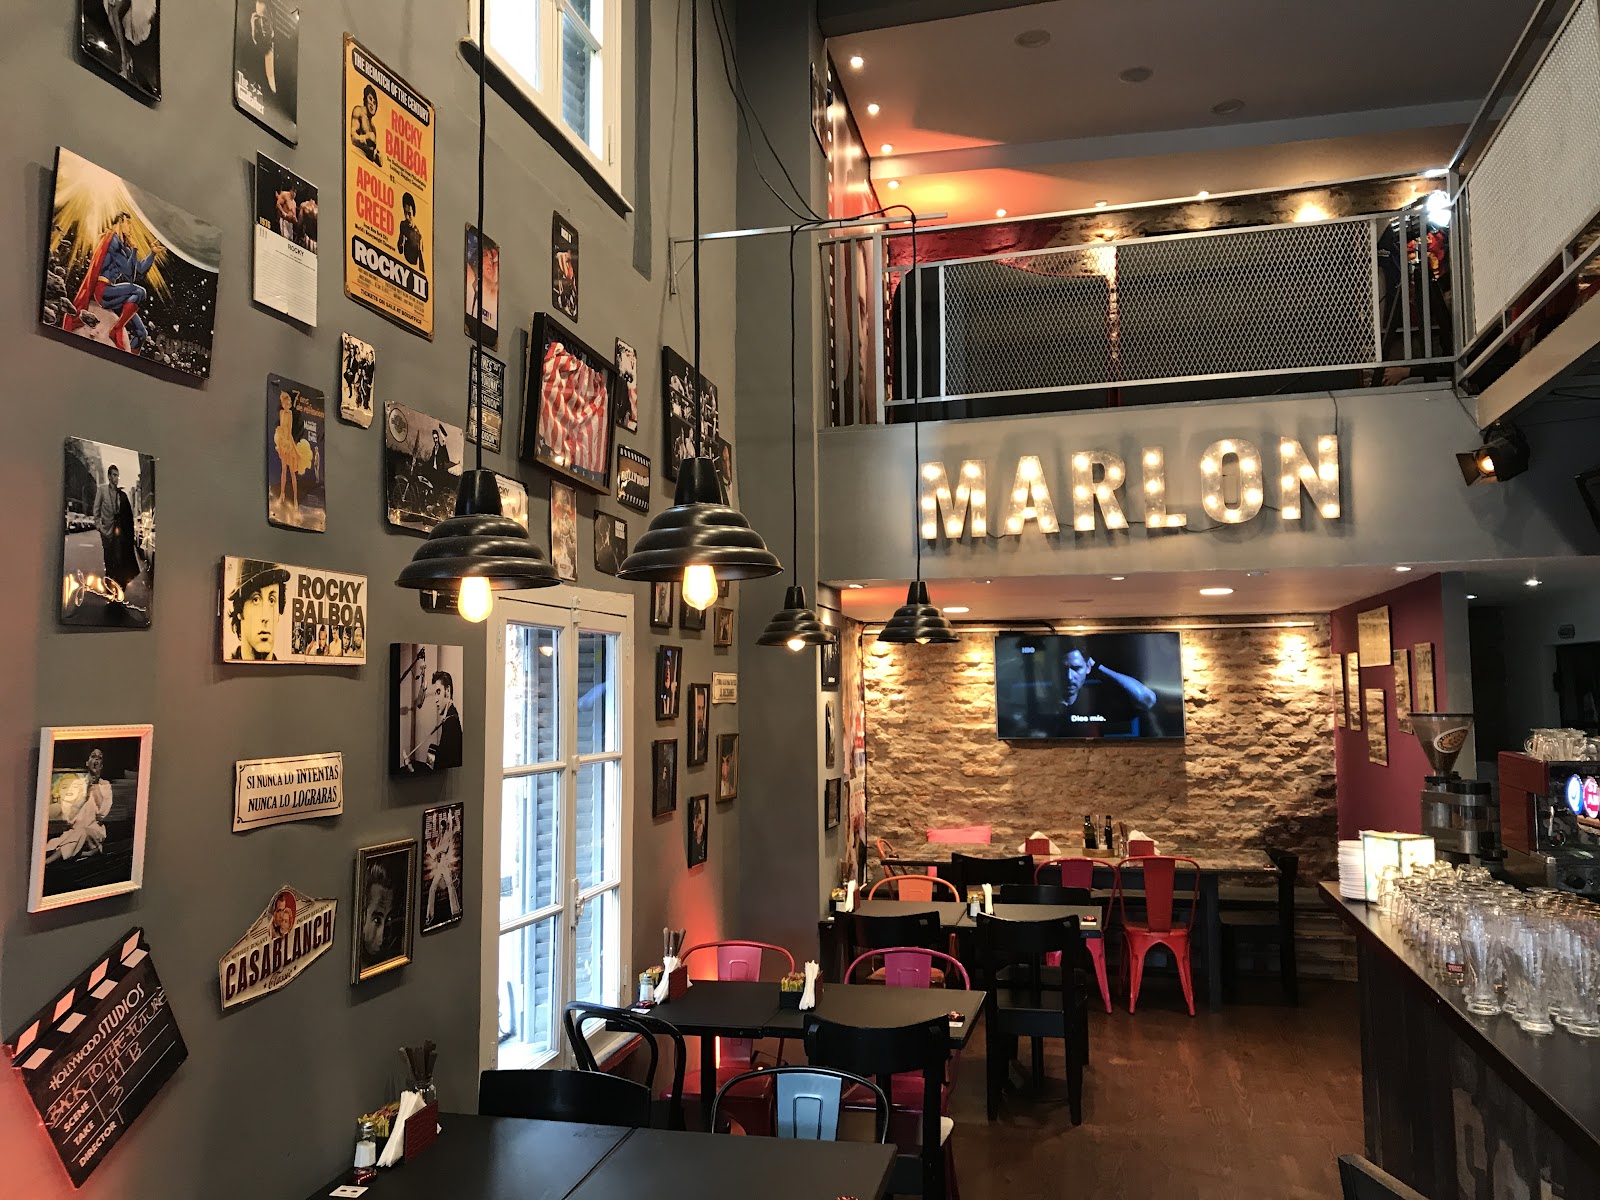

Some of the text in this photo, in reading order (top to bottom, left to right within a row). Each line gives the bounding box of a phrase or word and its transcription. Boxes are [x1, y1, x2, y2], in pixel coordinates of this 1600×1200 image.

[237, 70, 249, 90] The
[354, 51, 429, 123] THE REMATCH OF THE CENTURY
[391, 108, 423, 151] ROCKY
[385, 128, 428, 183] BALBOA
[356, 165, 395, 209] APOLLO
[355, 190, 395, 237] CREED
[287, 243, 305, 257] ROCKY
[354, 238, 411, 288] ROCKY
[412, 272, 427, 299] II
[360, 288, 378, 302] TICKETS
[920, 434, 1341, 541] MARLON
[297, 573, 362, 605] ROCKY
[292, 597, 365, 629] BALBOA
[1070, 714, 1089, 723] Dios
[246, 764, 339, 790] SI NUNCA LO INTENTAS
[247, 785, 338, 813] NUNCA LO LOGRARAS
[49, 982, 145, 1091] HOLLYWOOD STUDIOS
[46, 986, 168, 1128] BACK TO THE FUTURE
[63, 1100, 91, 1133] SCENE
[73, 1119, 96, 1146] TAKE
[78, 1120, 118, 1168] DIRECTOR
